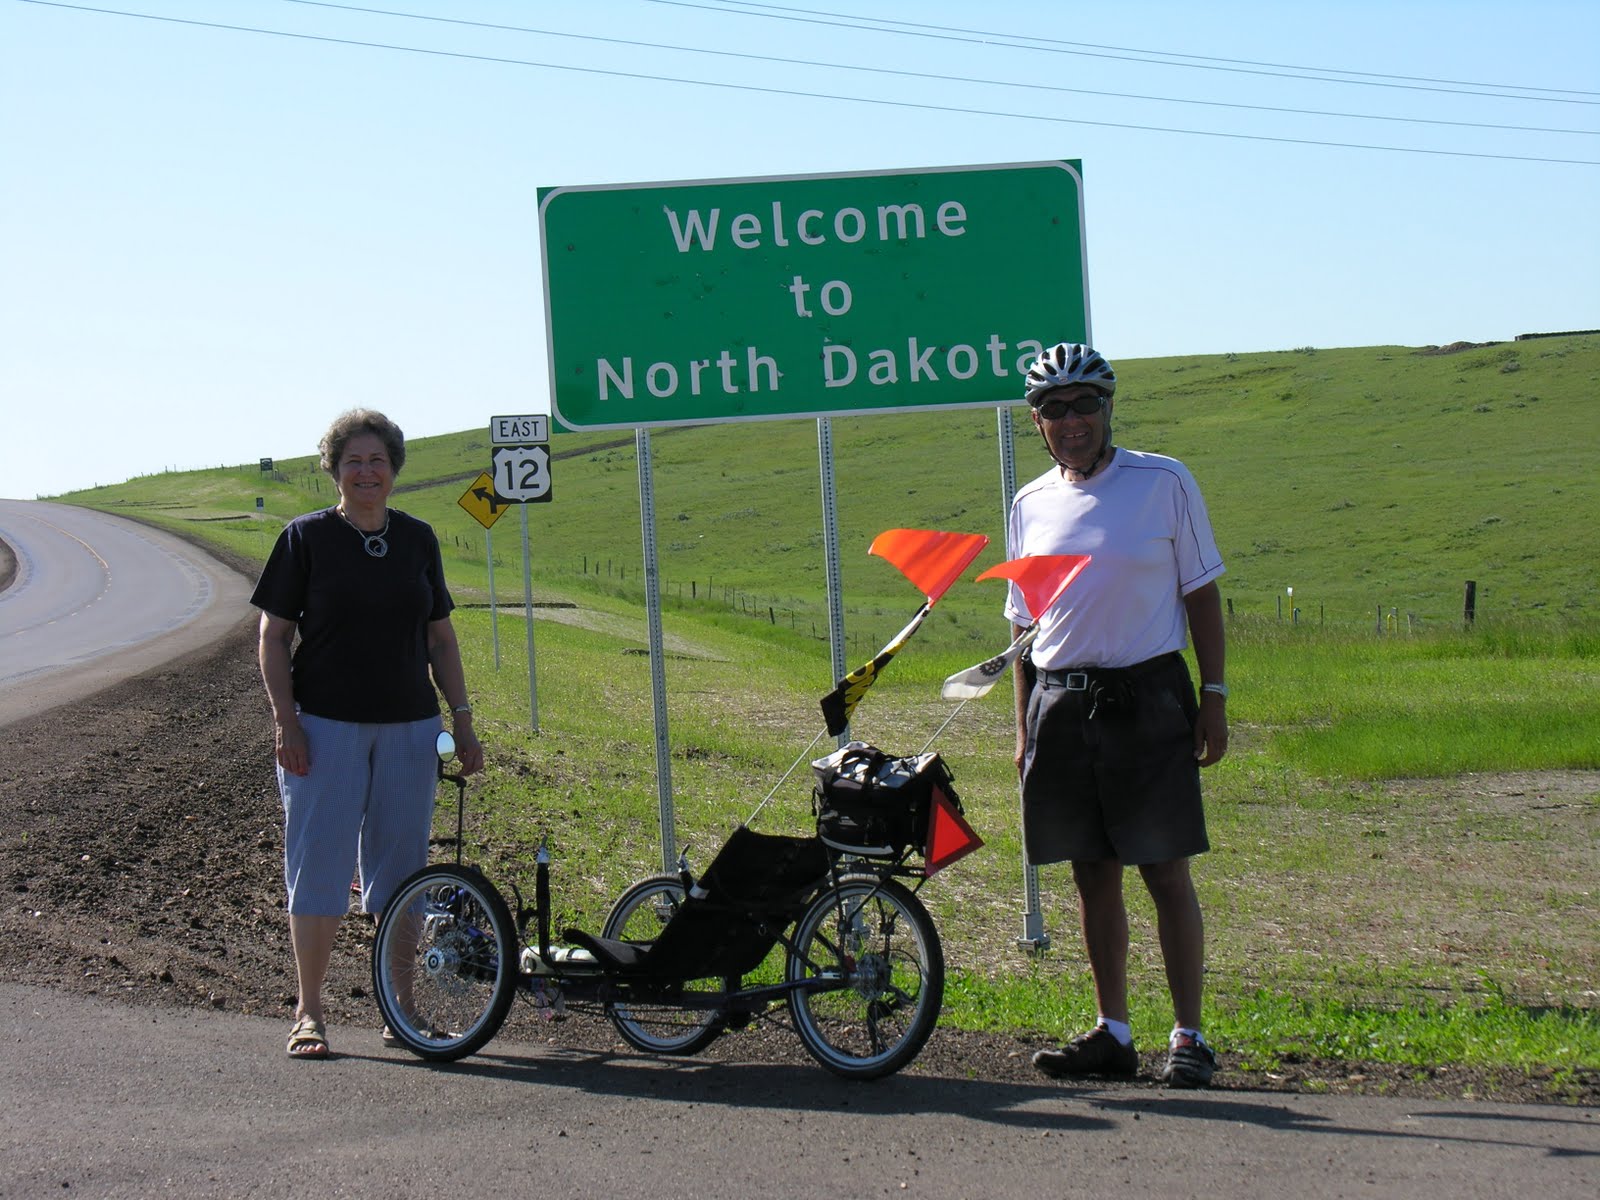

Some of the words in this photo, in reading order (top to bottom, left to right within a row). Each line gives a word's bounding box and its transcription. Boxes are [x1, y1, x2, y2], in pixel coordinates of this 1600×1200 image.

[663, 200, 968, 254] Welcome
[789, 275, 853, 318] to
[596, 346, 783, 401] North
[500, 420, 539, 437] EAST
[504, 459, 540, 490] 12
